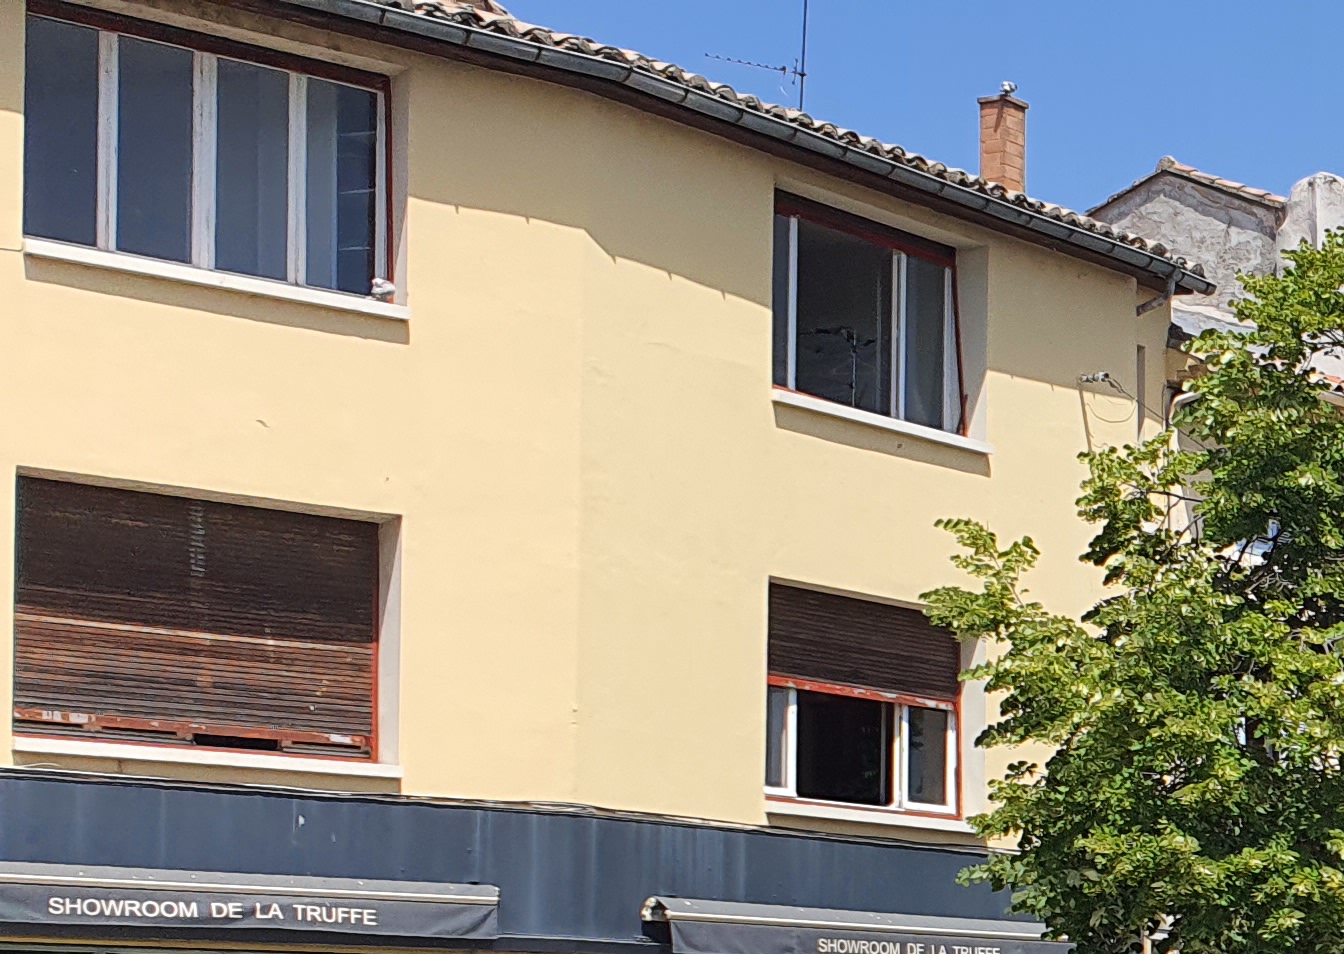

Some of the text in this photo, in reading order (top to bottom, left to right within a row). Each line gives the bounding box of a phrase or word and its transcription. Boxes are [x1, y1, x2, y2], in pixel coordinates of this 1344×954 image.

[48, 896, 378, 926] SHOWROOM DE LA TRUFFE
